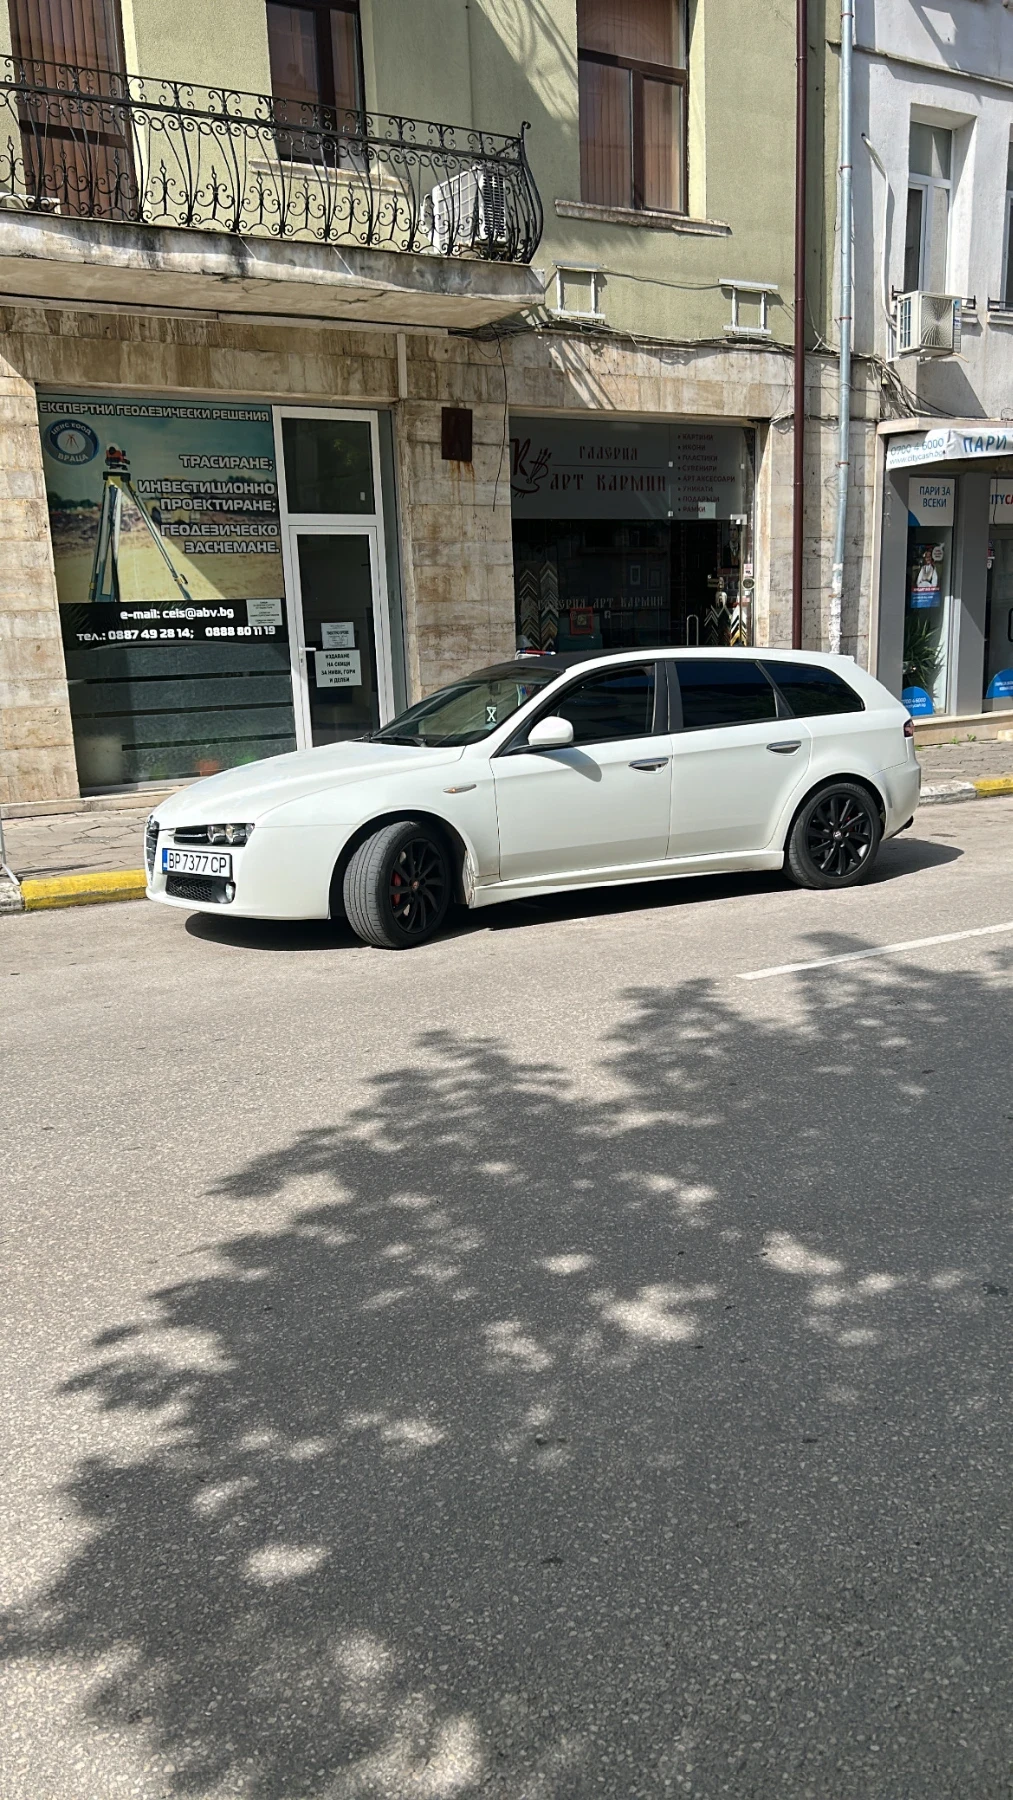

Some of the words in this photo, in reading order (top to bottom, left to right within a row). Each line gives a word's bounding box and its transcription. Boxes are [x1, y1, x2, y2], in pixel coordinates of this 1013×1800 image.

[39, 402, 115, 416] ЕКСПЕРТНИ
[116, 406, 211, 419] ГЕОДЕЗИЧЕСКИ
[212, 410, 270, 422] РЕШЕНИЯ
[922, 437, 944, 450] 6000
[963, 435, 1007, 453] ПАРИ
[57, 453, 90, 463] ВРАЦА
[579, 446, 638, 461] ГАЛЕРИЯ
[682, 454, 718, 462] ПЛАСТИКИ
[179, 454, 274, 470] ТРАСИРАНЕ;
[138, 480, 276, 494] ИНВЕСТИЦИОННО
[550, 473, 585, 491] АРТ
[597, 473, 666, 492] КАРМИН
[919, 486, 940, 496] ПАРИ
[941, 487, 952, 496] ЗА
[160, 499, 277, 513] ПРОЕКТИРАНЕ;
[922, 498, 947, 508] ВСЕКИ
[160, 524, 278, 536] ГЕОДЕЗИЧЕСКО
[184, 541, 280, 554] ЗАСНЕМАНЕ.
[119, 608, 160, 620] e-mail:
[162, 607, 235, 620] ceis@abv.bg
[76, 631, 106, 641] тел.:
[107, 630, 139, 640] 0887
[140, 629, 158, 639] 49
[159, 629, 175, 638] 28
[177, 627, 195, 639] 14;
[204, 627, 236, 637] 0888
[237, 626, 252, 636] 80
[253, 626, 263, 636] 11
[264, 625, 276, 635] 19
